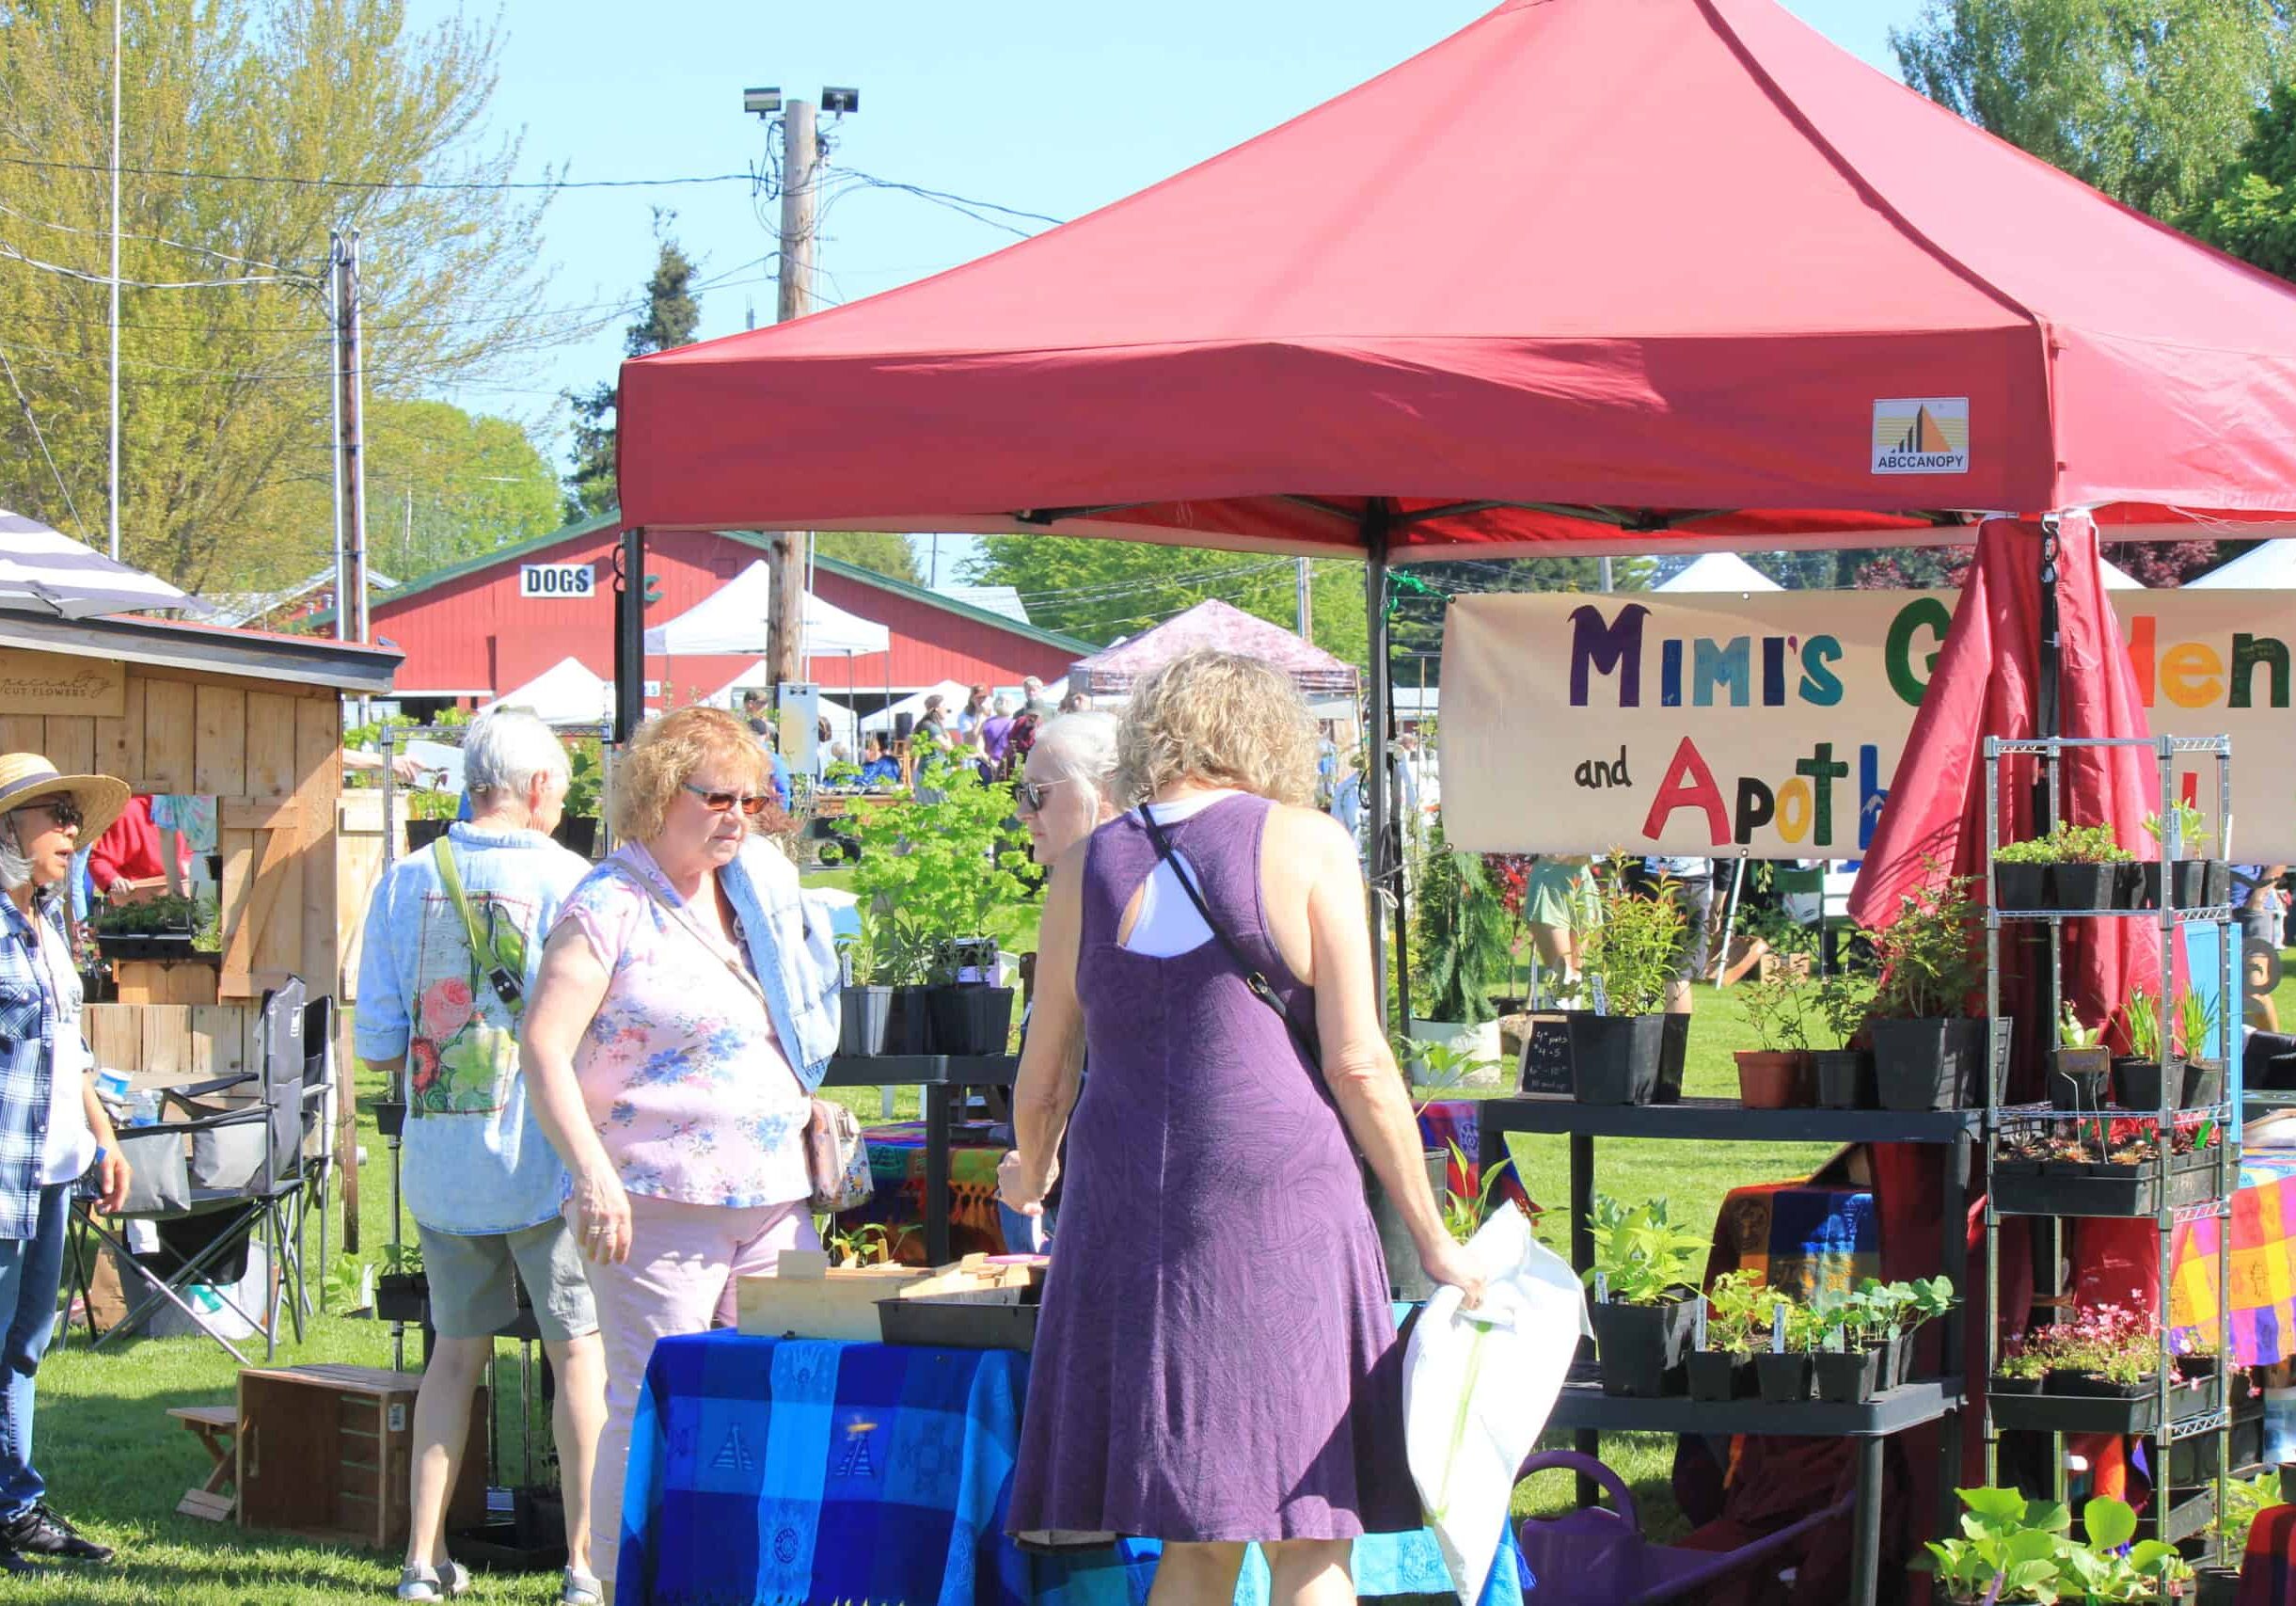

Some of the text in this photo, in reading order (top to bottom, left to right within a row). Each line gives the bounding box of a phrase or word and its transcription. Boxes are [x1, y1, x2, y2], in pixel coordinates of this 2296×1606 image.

[1877, 455, 1964, 468] ABCCANOPY
[527, 568, 590, 593] DOGS
[1575, 745, 1632, 788] and
